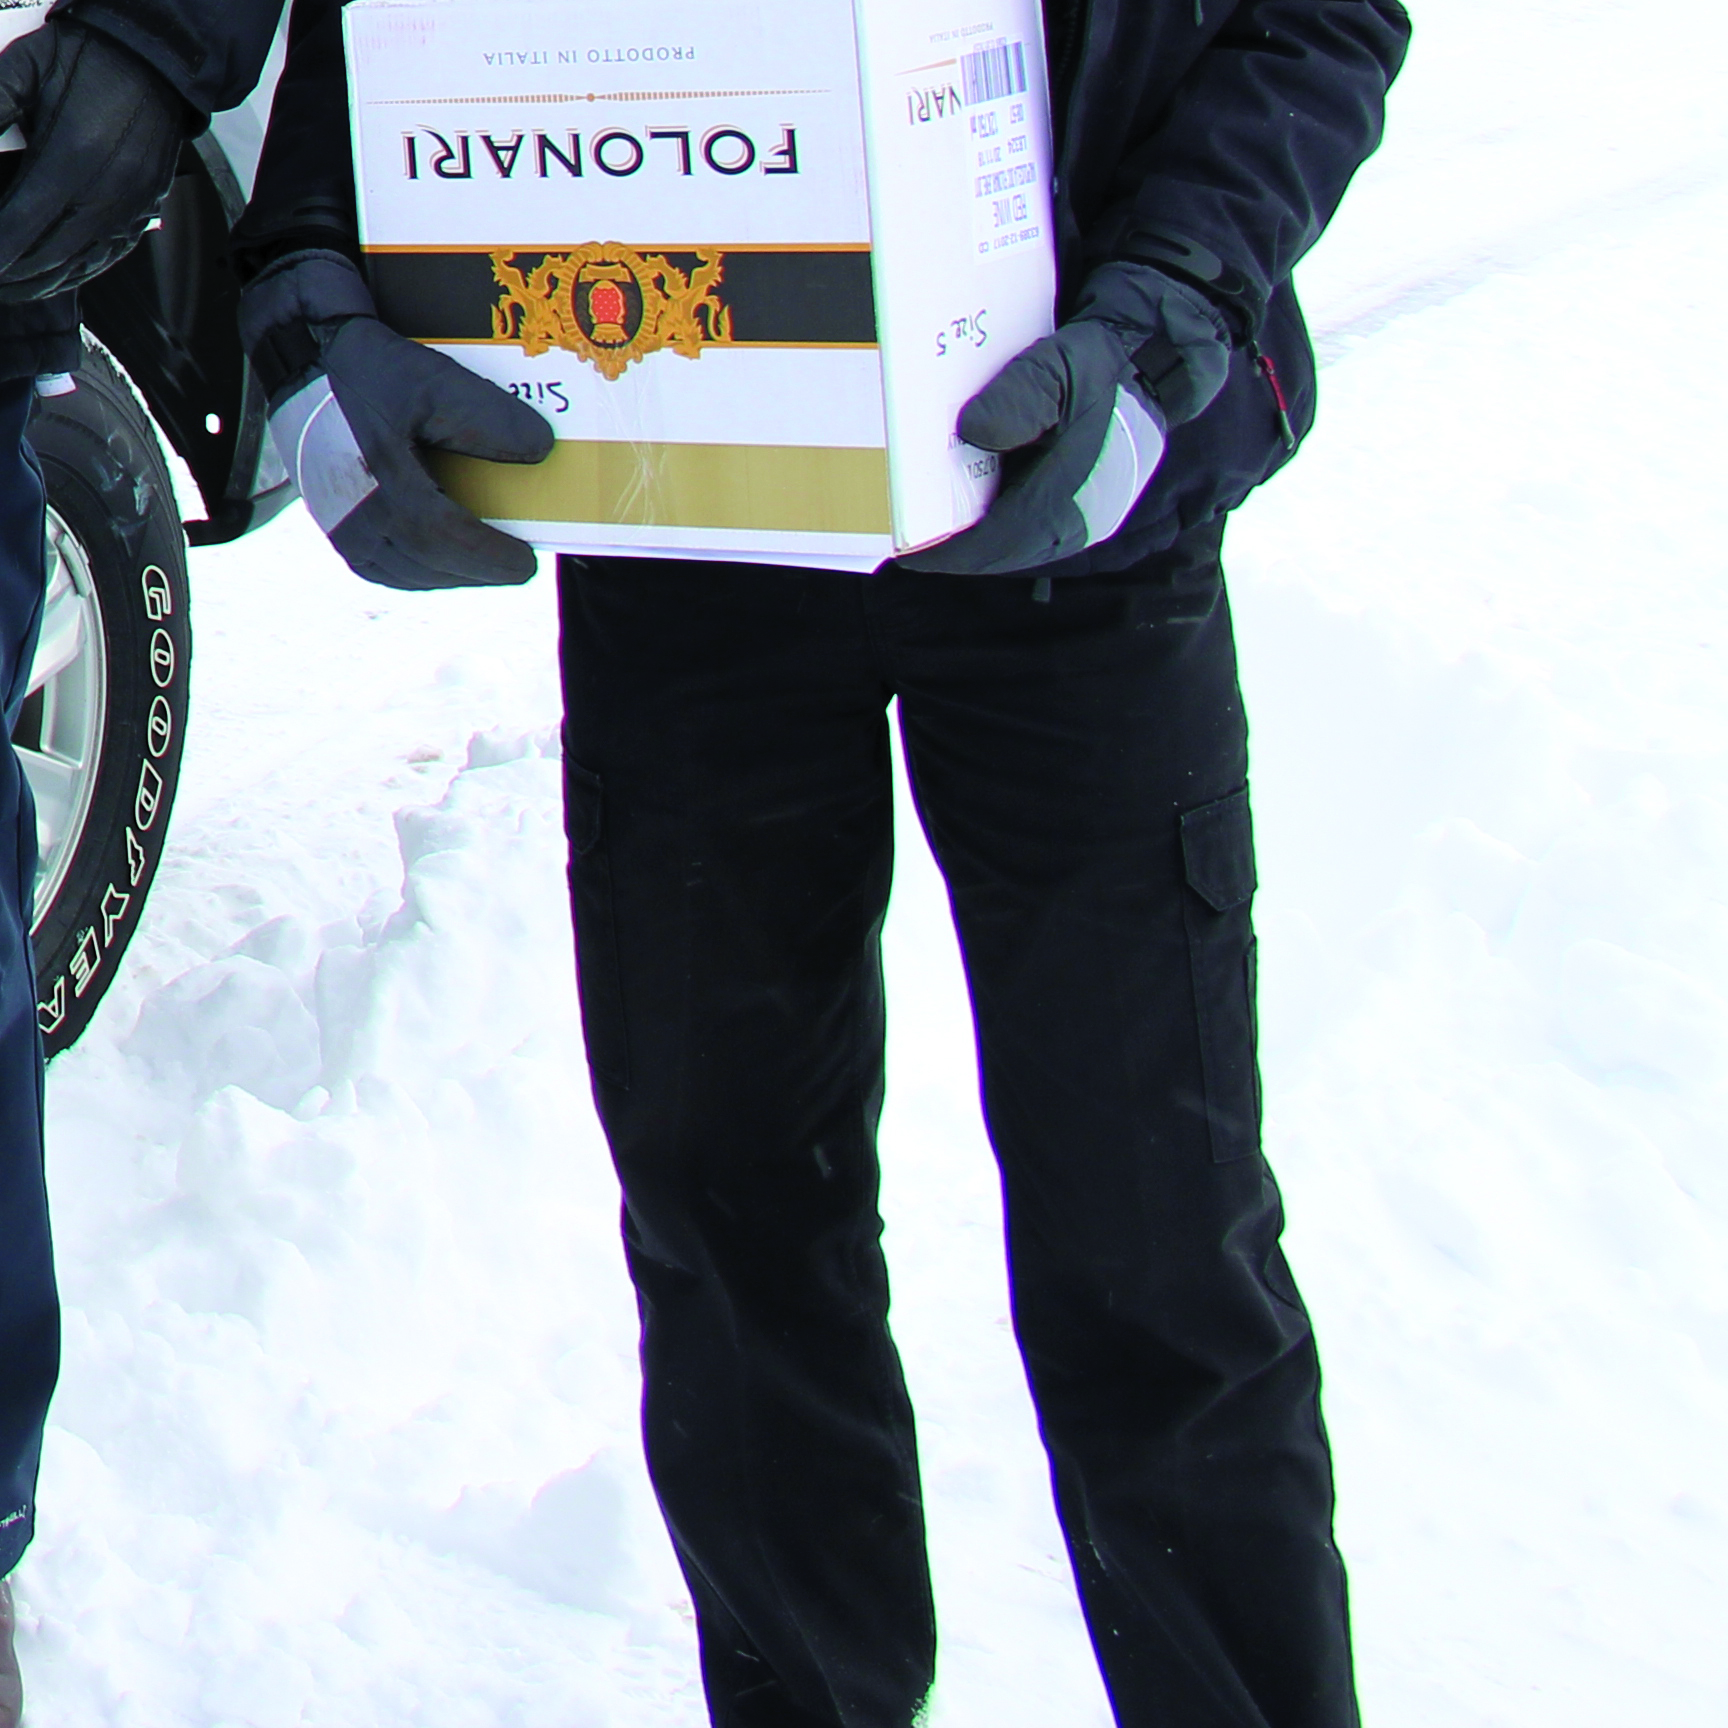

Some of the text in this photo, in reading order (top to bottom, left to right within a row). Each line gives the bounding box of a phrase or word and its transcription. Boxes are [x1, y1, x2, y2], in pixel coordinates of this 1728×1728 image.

[482, 45, 695, 66] PRODOTTO IN ITALIA
[400, 122, 801, 181] FOLONARI
[950, 309, 987, 347] Size
[37, 563, 176, 1034] GOODYEA
